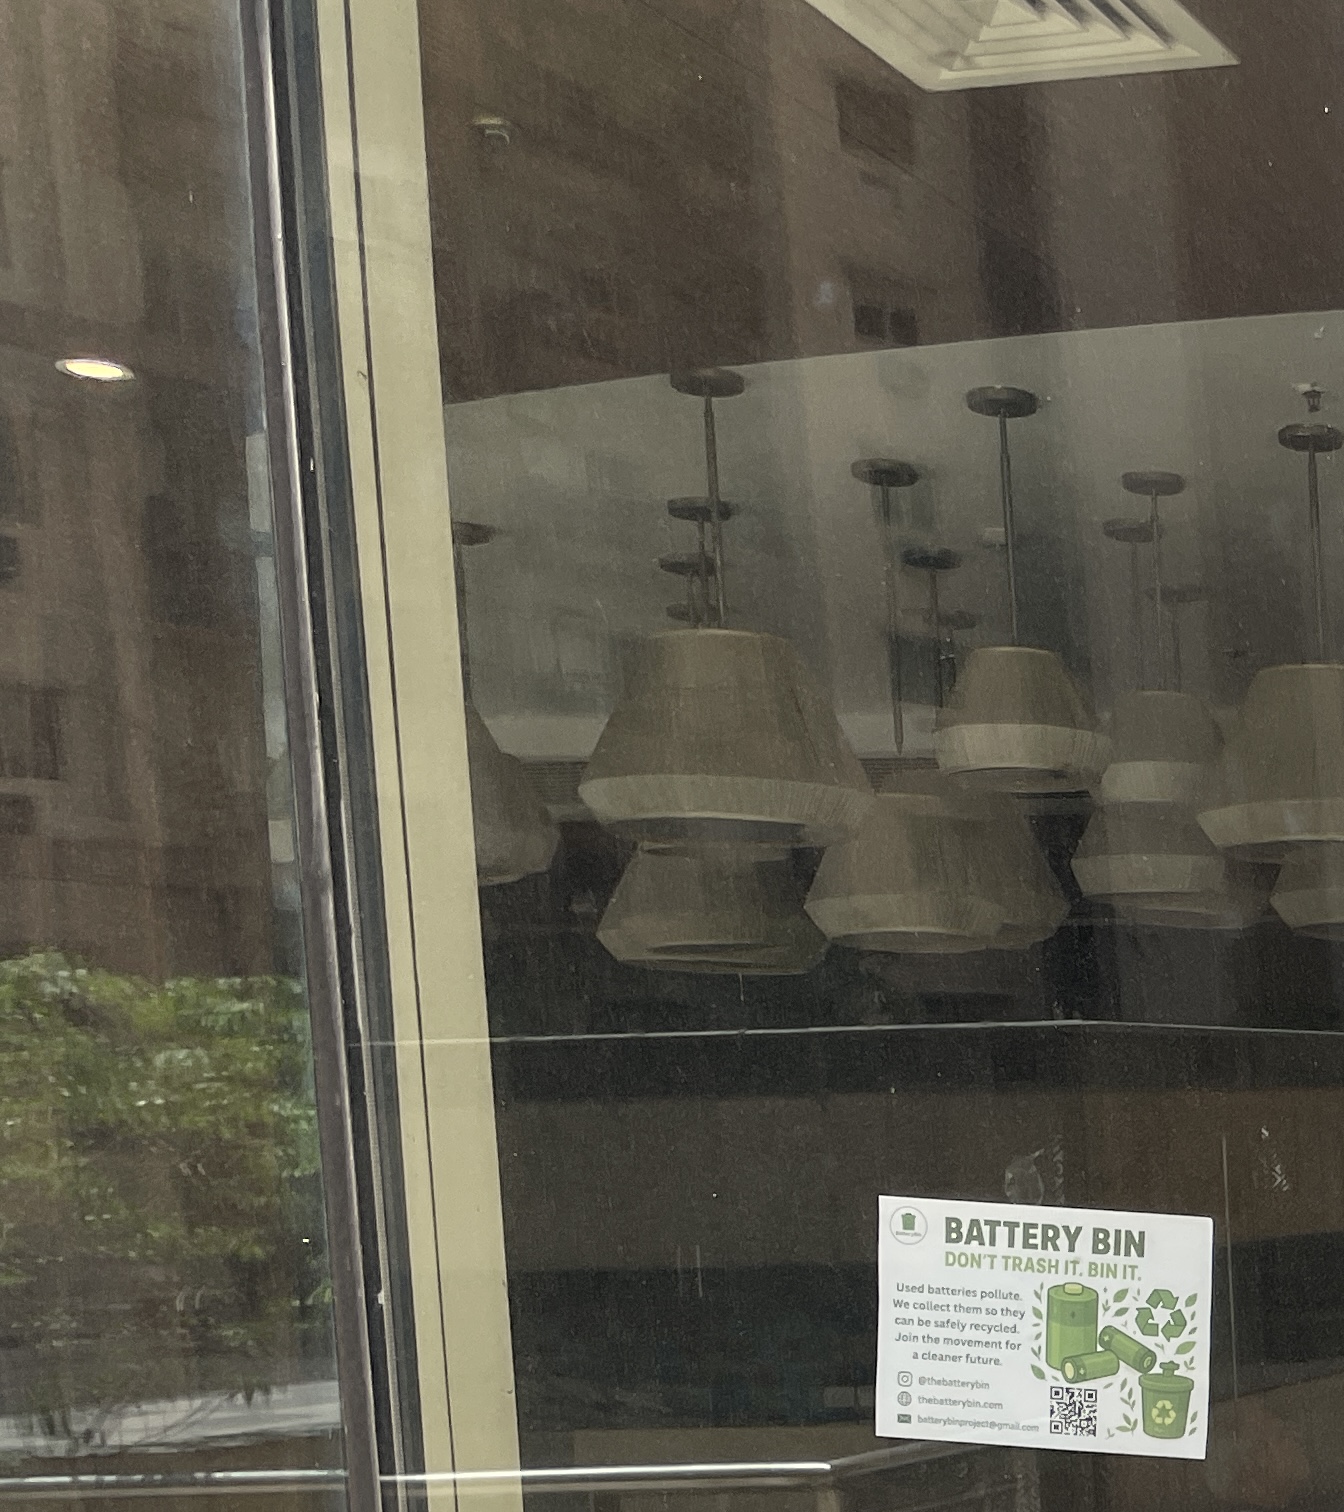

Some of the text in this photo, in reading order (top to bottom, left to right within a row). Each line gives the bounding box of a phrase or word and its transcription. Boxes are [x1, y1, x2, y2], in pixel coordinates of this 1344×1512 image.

[945, 1216, 1146, 1258] BATTERY BIN
[945, 1251, 1142, 1281] DON'T TRASH IT. BIN IT.
[896, 1282, 1023, 1301] Used batteries pollute.
[893, 1298, 1026, 1321] We collect them so they
[894, 1317, 1021, 1335] can be safely recycled.
[895, 1332, 1022, 1351] Join the movement for
[912, 1351, 1003, 1366] a cleaner future.
